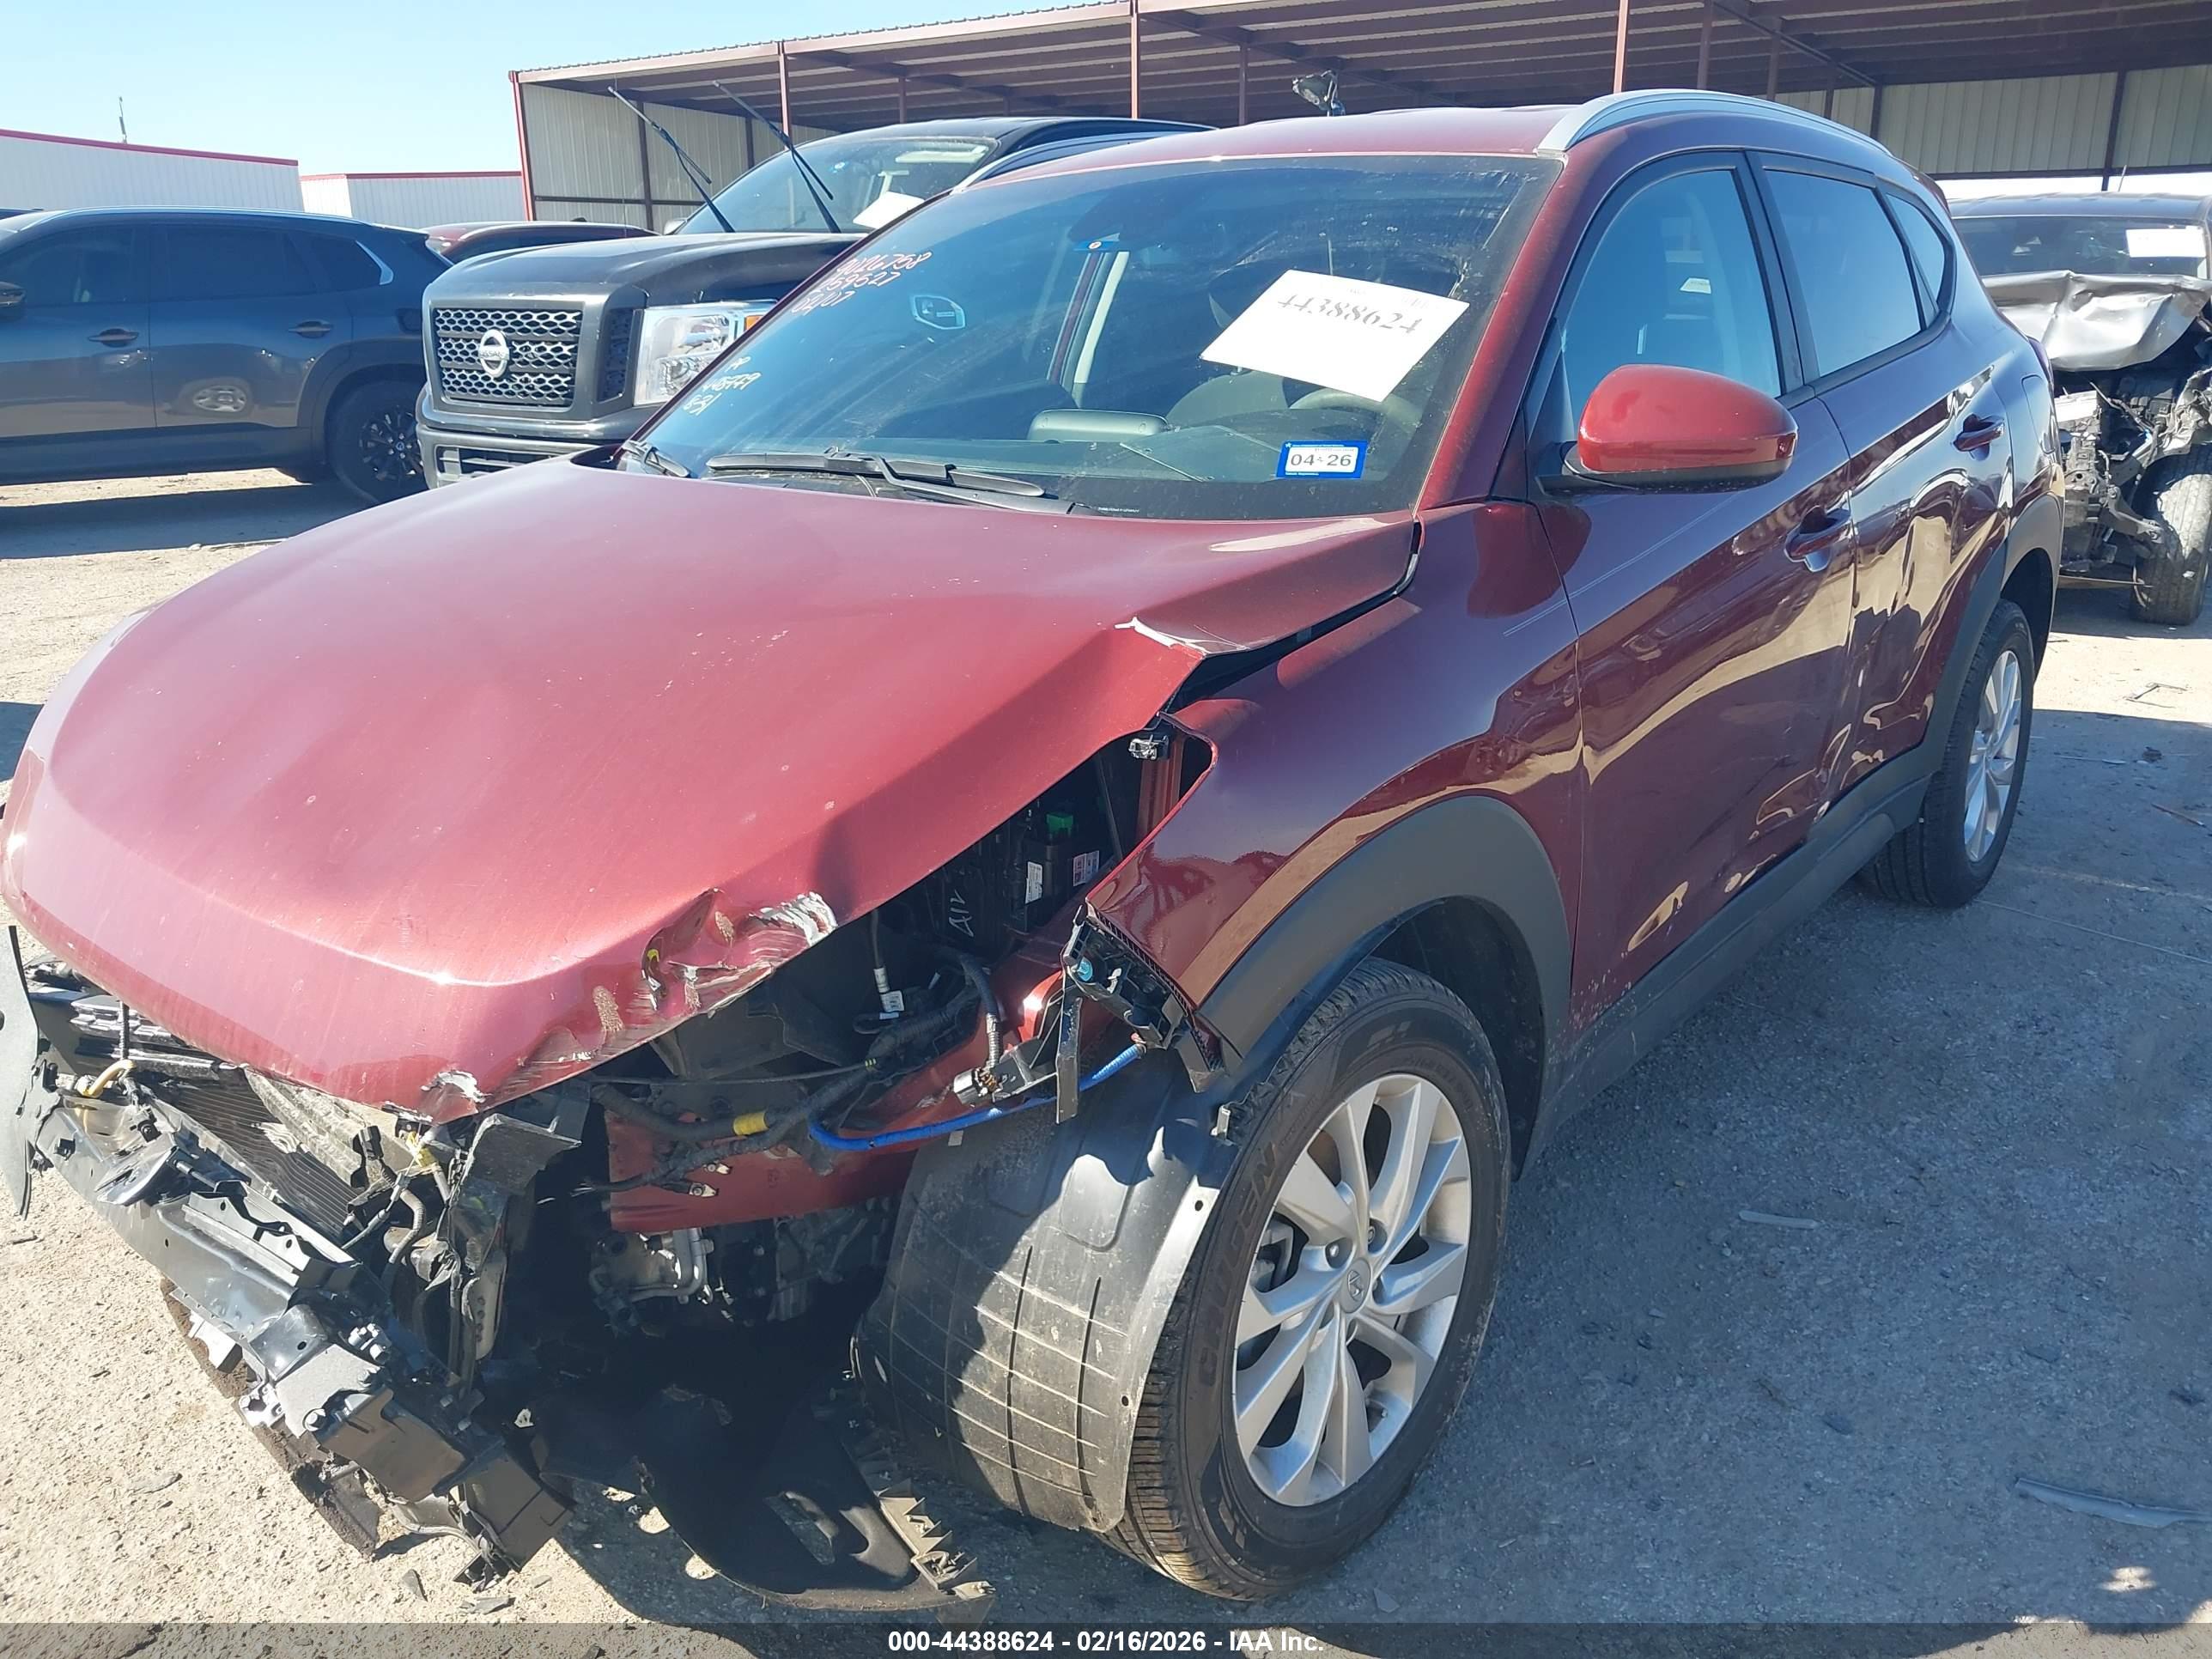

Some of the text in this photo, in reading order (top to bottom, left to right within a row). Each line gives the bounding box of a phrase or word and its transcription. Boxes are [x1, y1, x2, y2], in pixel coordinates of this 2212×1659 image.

[1277, 295, 1423, 333] 44388624
[1291, 453, 1353, 466] 04 26
